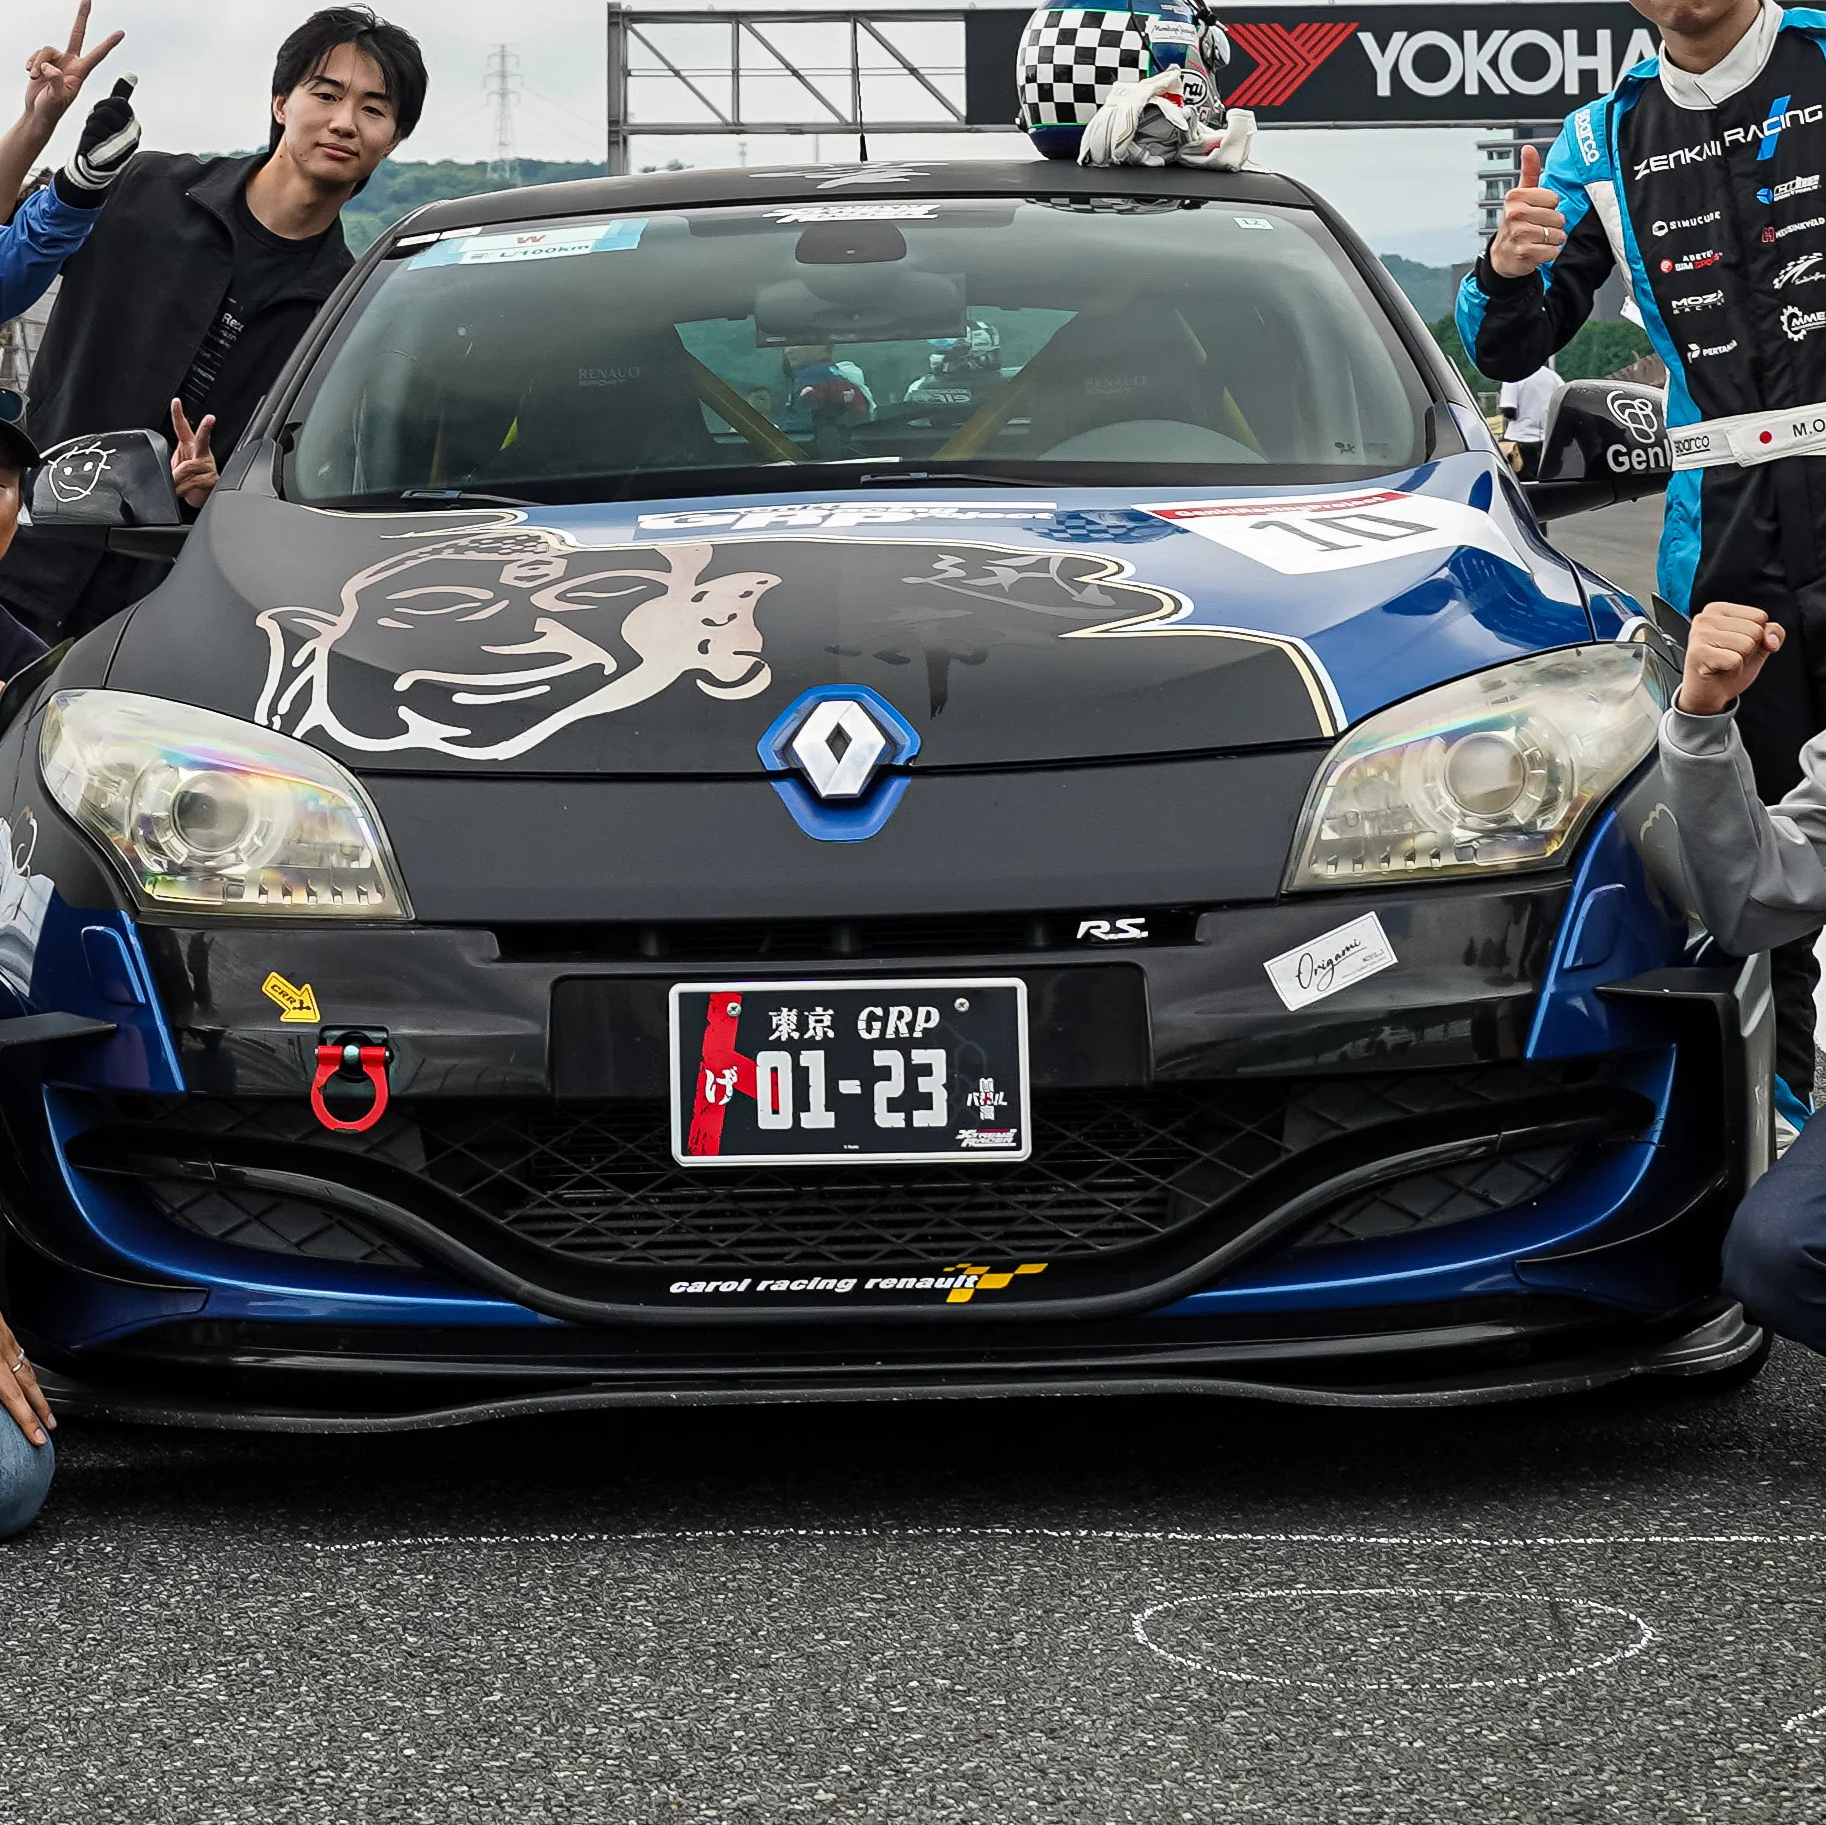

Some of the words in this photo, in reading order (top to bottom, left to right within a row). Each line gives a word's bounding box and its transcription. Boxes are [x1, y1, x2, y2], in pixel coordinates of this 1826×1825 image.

[1723, 104, 1823, 147] RACING
[1791, 311, 1826, 327] MME
[1248, 514, 1439, 552] 10
[1295, 938, 1368, 992] Origami
[768, 1006, 836, 1042] 東京
[857, 1005, 941, 1041] GRP
[704, 1065, 739, 1106] げ
[756, 1047, 949, 1130] 01-23
[669, 1277, 751, 1294] carol
[755, 1276, 858, 1293] racing
[863, 1274, 979, 1290] renault
